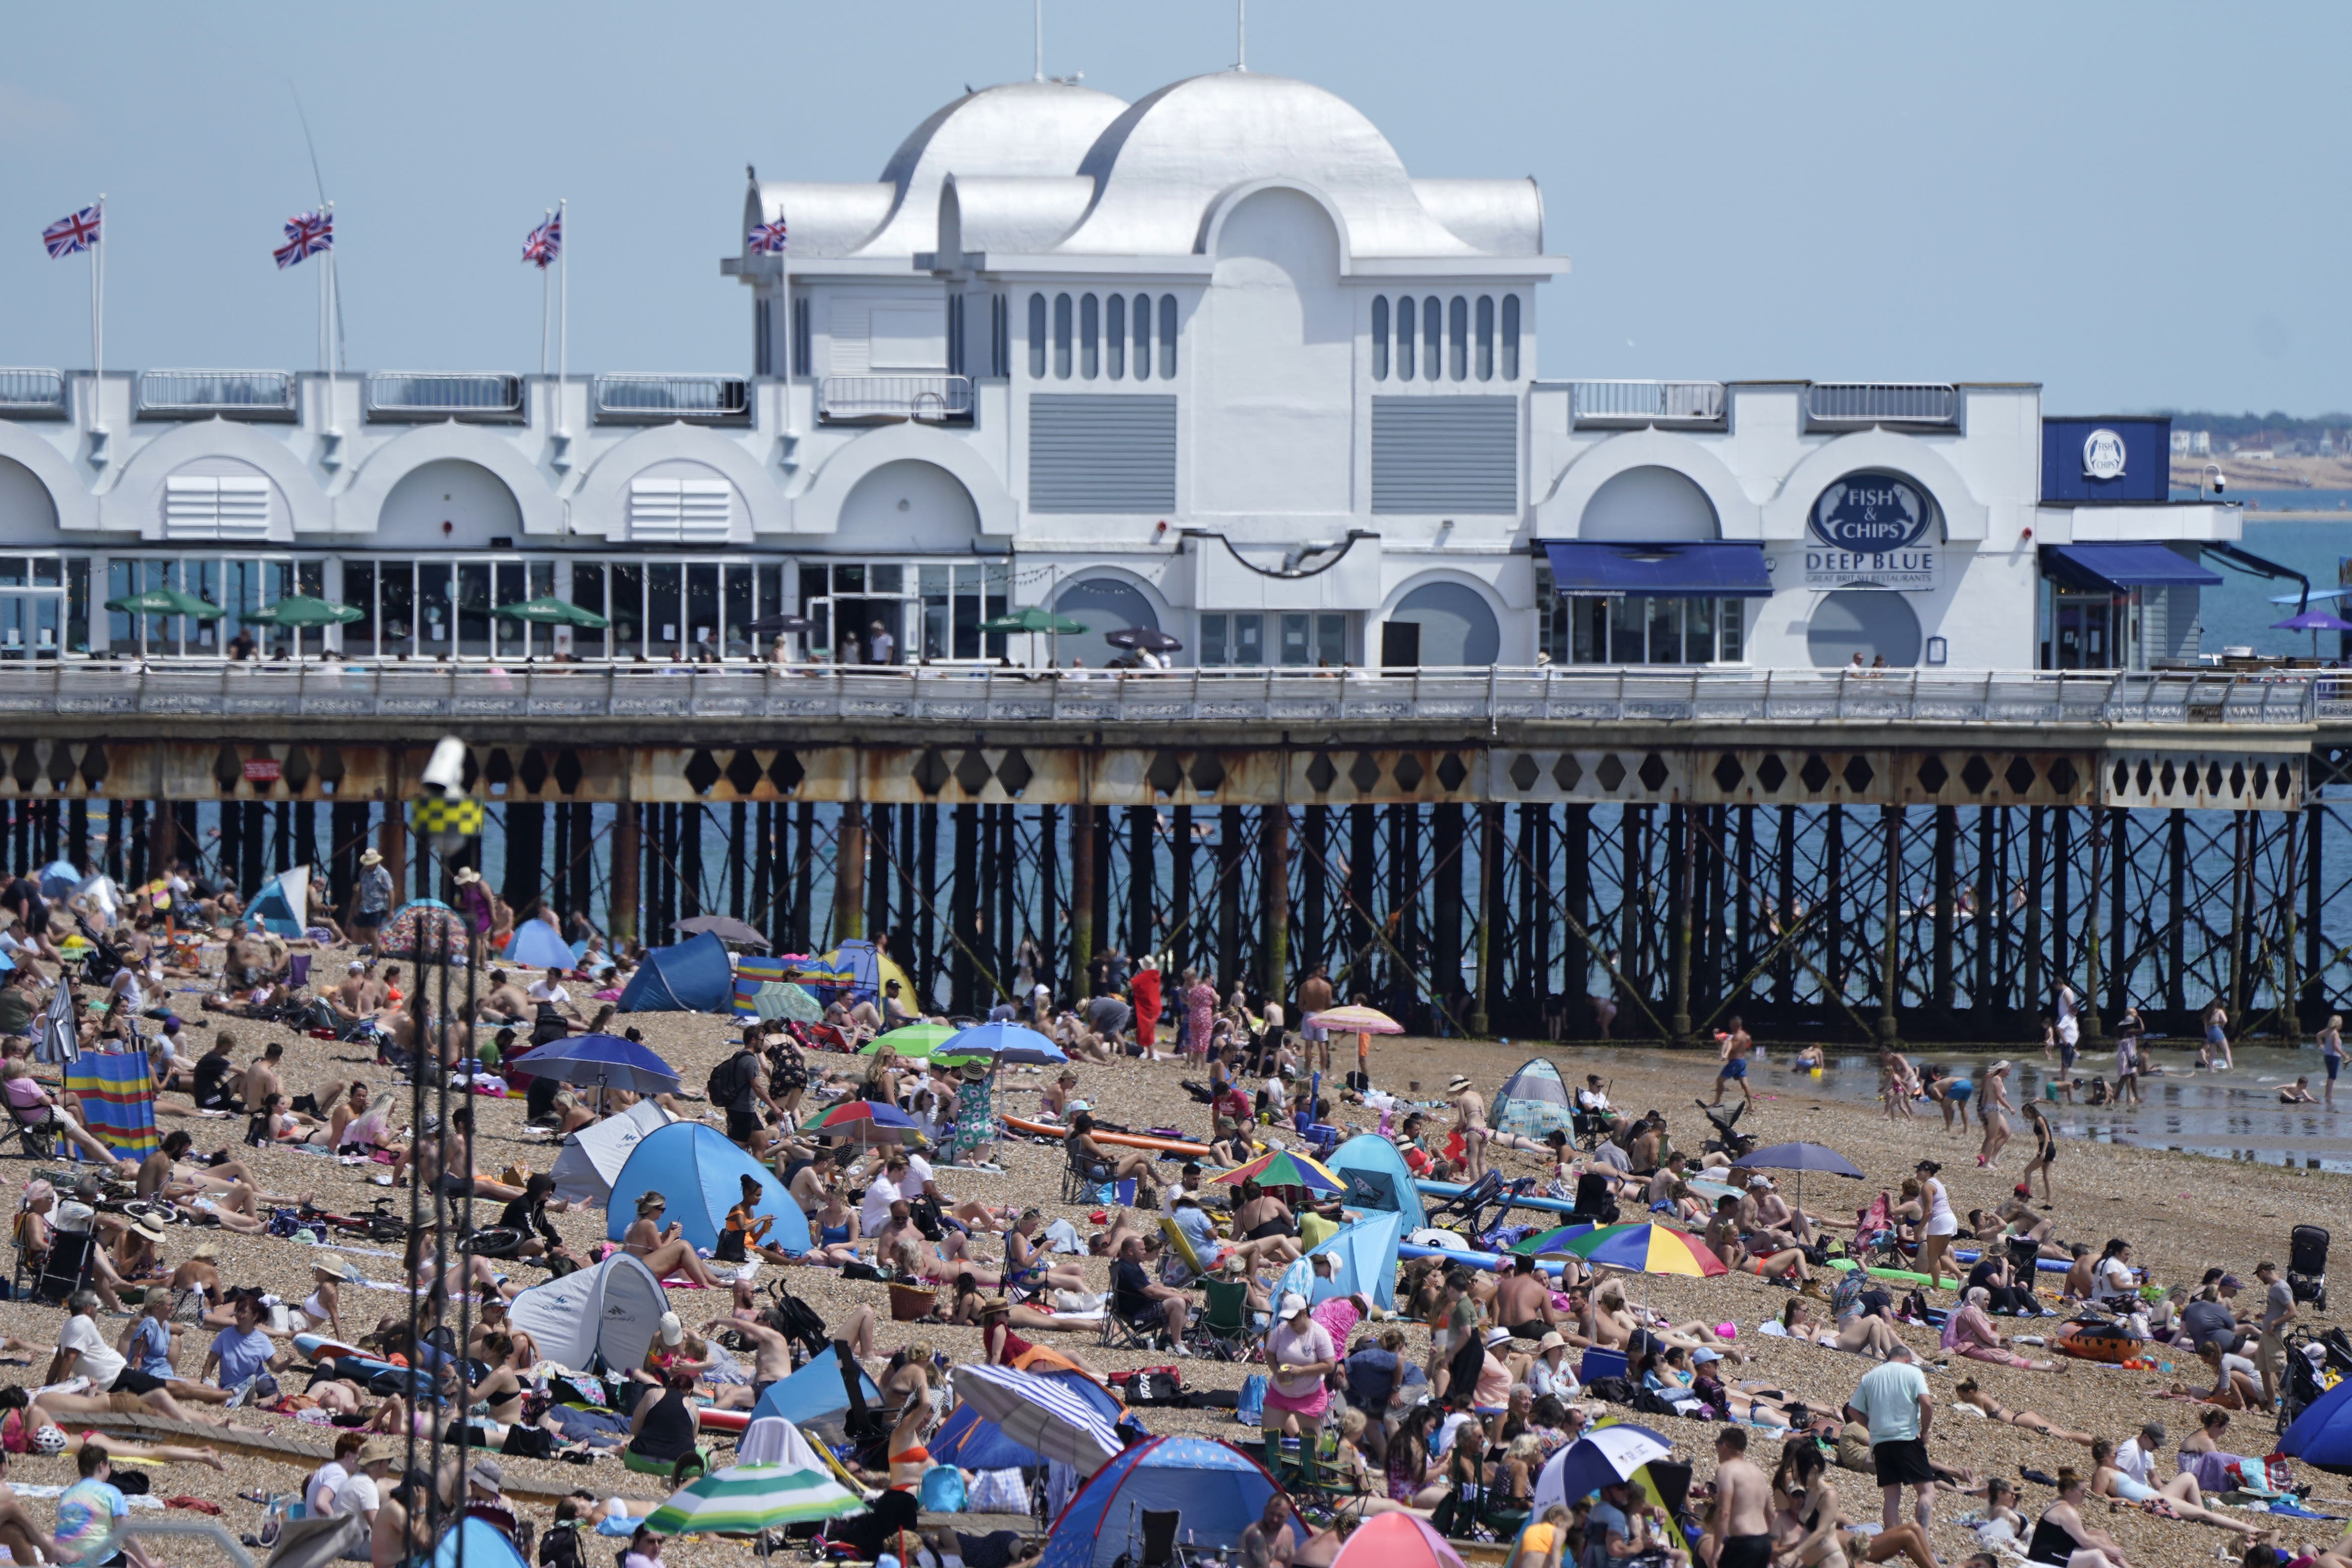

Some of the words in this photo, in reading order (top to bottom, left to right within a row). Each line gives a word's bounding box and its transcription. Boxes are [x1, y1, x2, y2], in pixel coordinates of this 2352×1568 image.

[2099, 442, 2113, 451] FISH
[2097, 461, 2115, 469] CHIPS
[1848, 490, 1893, 505] FISH
[1864, 506, 1877, 521] &
[1842, 522, 1899, 538] CHIPS
[1806, 553, 1864, 569] DEEP
[1873, 553, 1932, 569] BLUE
